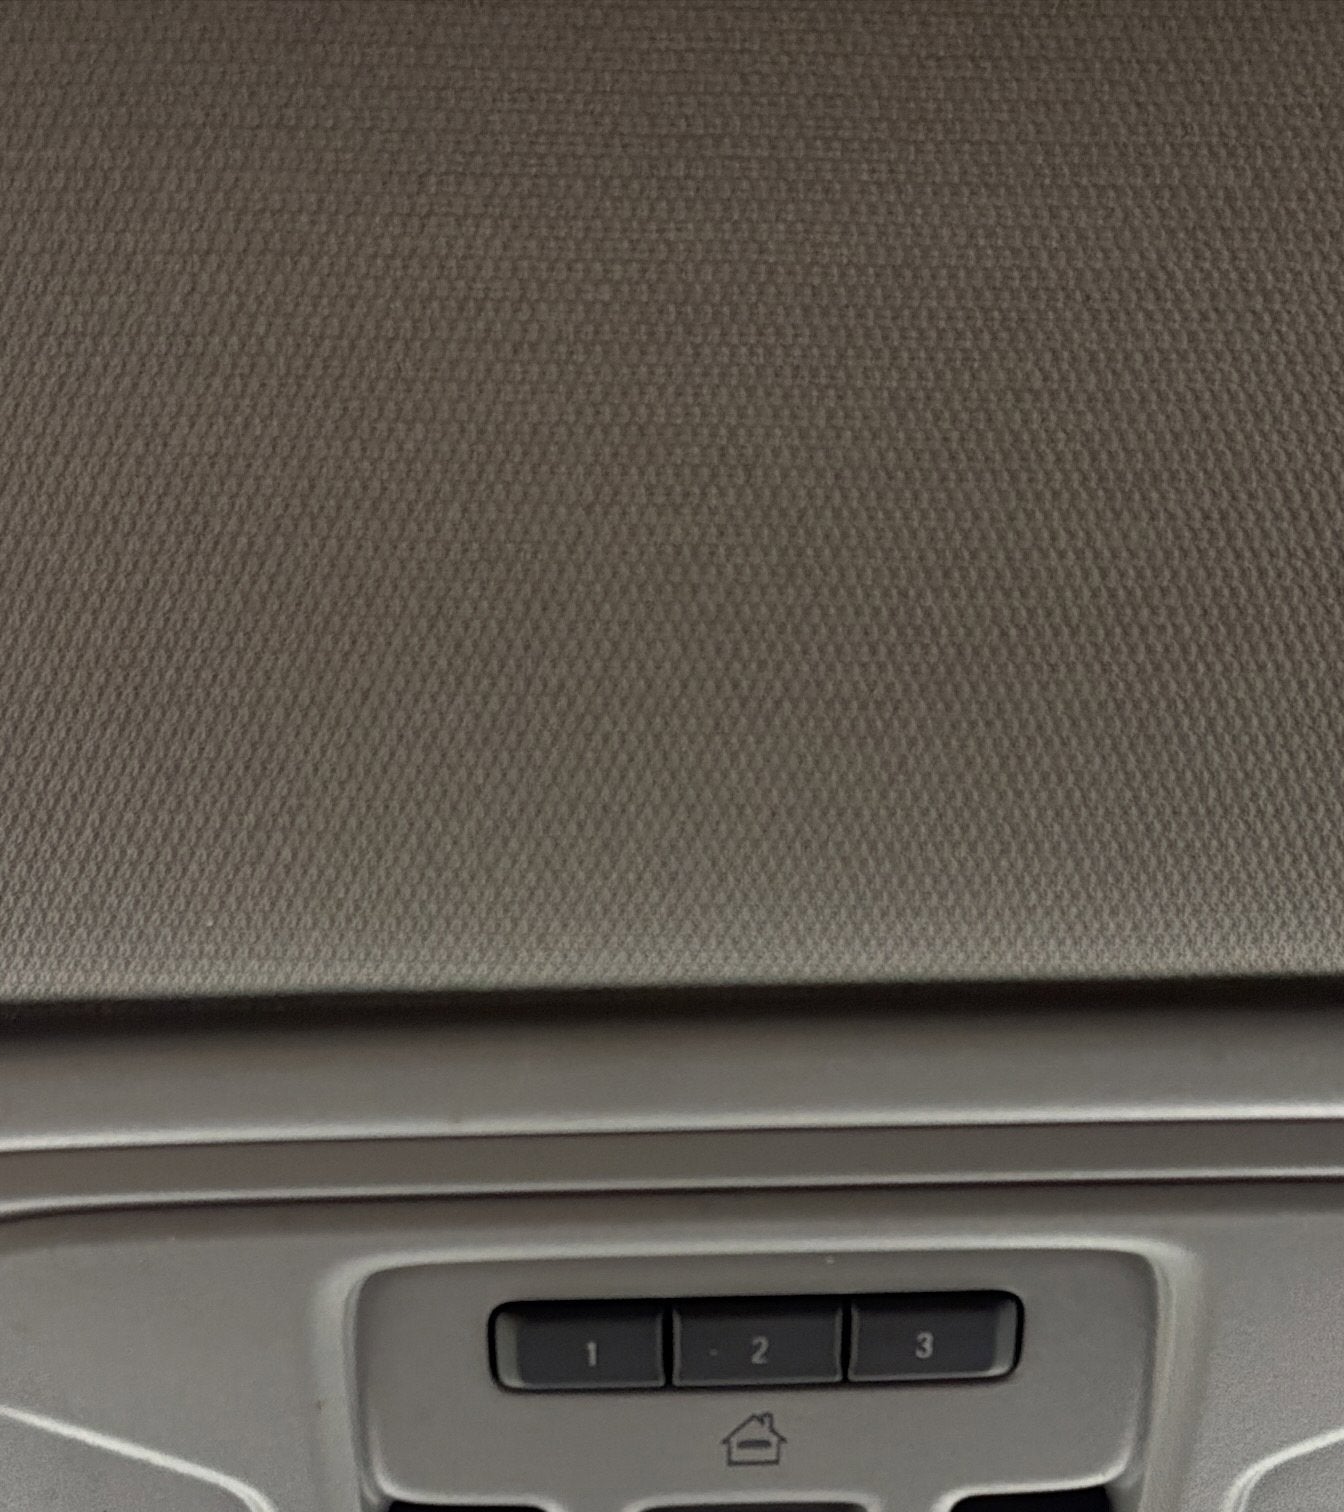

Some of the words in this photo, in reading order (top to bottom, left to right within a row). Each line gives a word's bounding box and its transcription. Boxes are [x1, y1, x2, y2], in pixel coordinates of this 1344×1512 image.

[586, 1340, 598, 1367] 1
[750, 1335, 769, 1364] 2
[914, 1331, 935, 1359] 3
